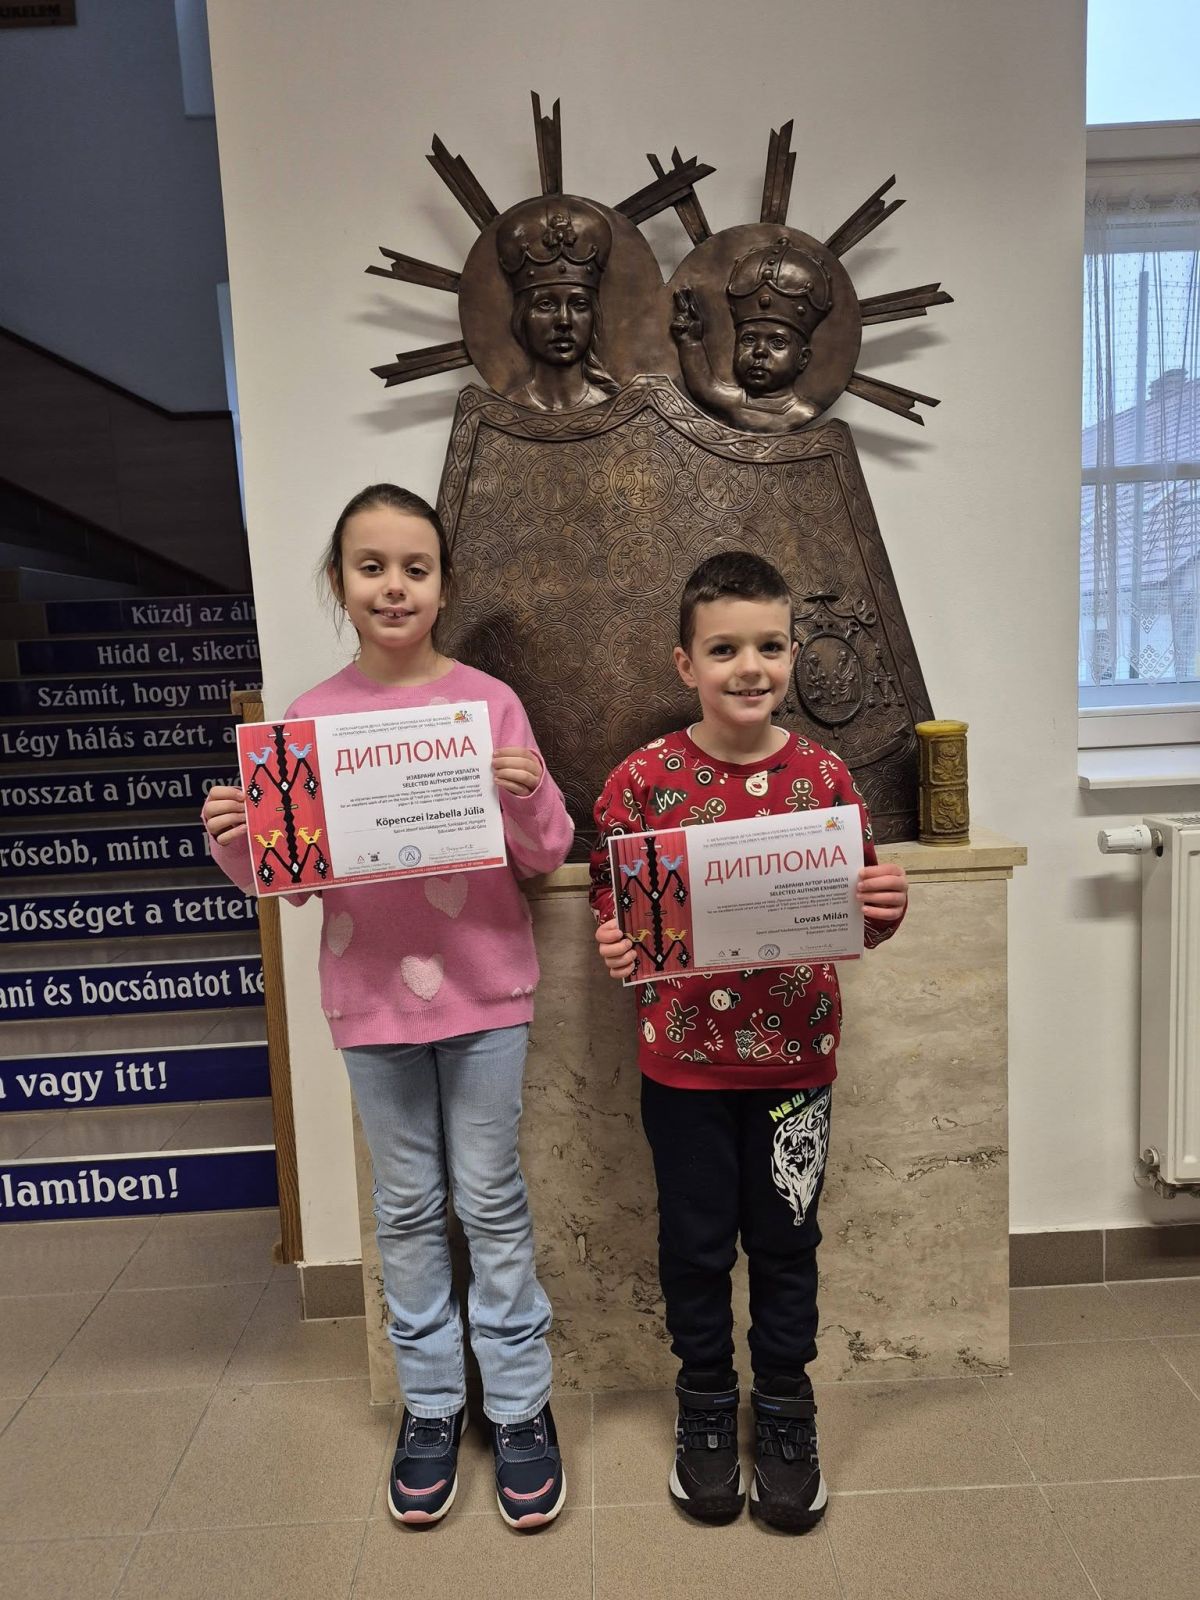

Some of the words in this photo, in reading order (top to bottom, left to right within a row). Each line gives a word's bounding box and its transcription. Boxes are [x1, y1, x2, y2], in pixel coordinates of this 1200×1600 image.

[132, 604, 193, 627] Küzdj
[200, 607, 224, 621] az
[97, 643, 150, 665] Hidd
[158, 642, 184, 664] el,
[38, 682, 125, 707] Számít,
[133, 682, 190, 707] hogy
[200, 678, 236, 700] mit
[2, 731, 59, 758] Légy
[67, 726, 135, 751] hálás
[143, 723, 213, 747] azért,
[334, 735, 478, 777] ДИПЛОМА
[402, 780, 428, 789] SELECTED
[429, 777, 452, 786] AUTHOR
[452, 774, 481, 783] EXHIBITOR
[406, 772, 436, 781] ИЗАБРАНИ
[436, 770, 454, 778] АУТОР
[1, 779, 95, 806] rosszat
[103, 784, 119, 802] a
[127, 774, 192, 806] jóval
[375, 814, 424, 828] Köpenczei
[426, 809, 462, 821] Izabella
[463, 806, 485, 817] Júlia
[107, 836, 174, 861] mint
[179, 839, 195, 857] a
[704, 845, 848, 887] ДИПЛОМА
[769, 889, 796, 897] SELECTED
[797, 886, 820, 894] AUTHOR
[820, 884, 849, 892] EXHIBITOR
[774, 882, 804, 890] ИЗАБРАНИ
[145, 904, 163, 924] a
[172, 896, 259, 922] tettei
[794, 915, 821, 924] Lovas
[822, 910, 848, 921] Milán
[43, 976, 73, 1006] és
[79, 970, 232, 1004] bocsánatot
[15, 1069, 103, 1102] vagy
[114, 1060, 168, 1092] itt!
[768, 1091, 805, 1122] NEW
[0, 1167, 180, 1208] lamiben!
